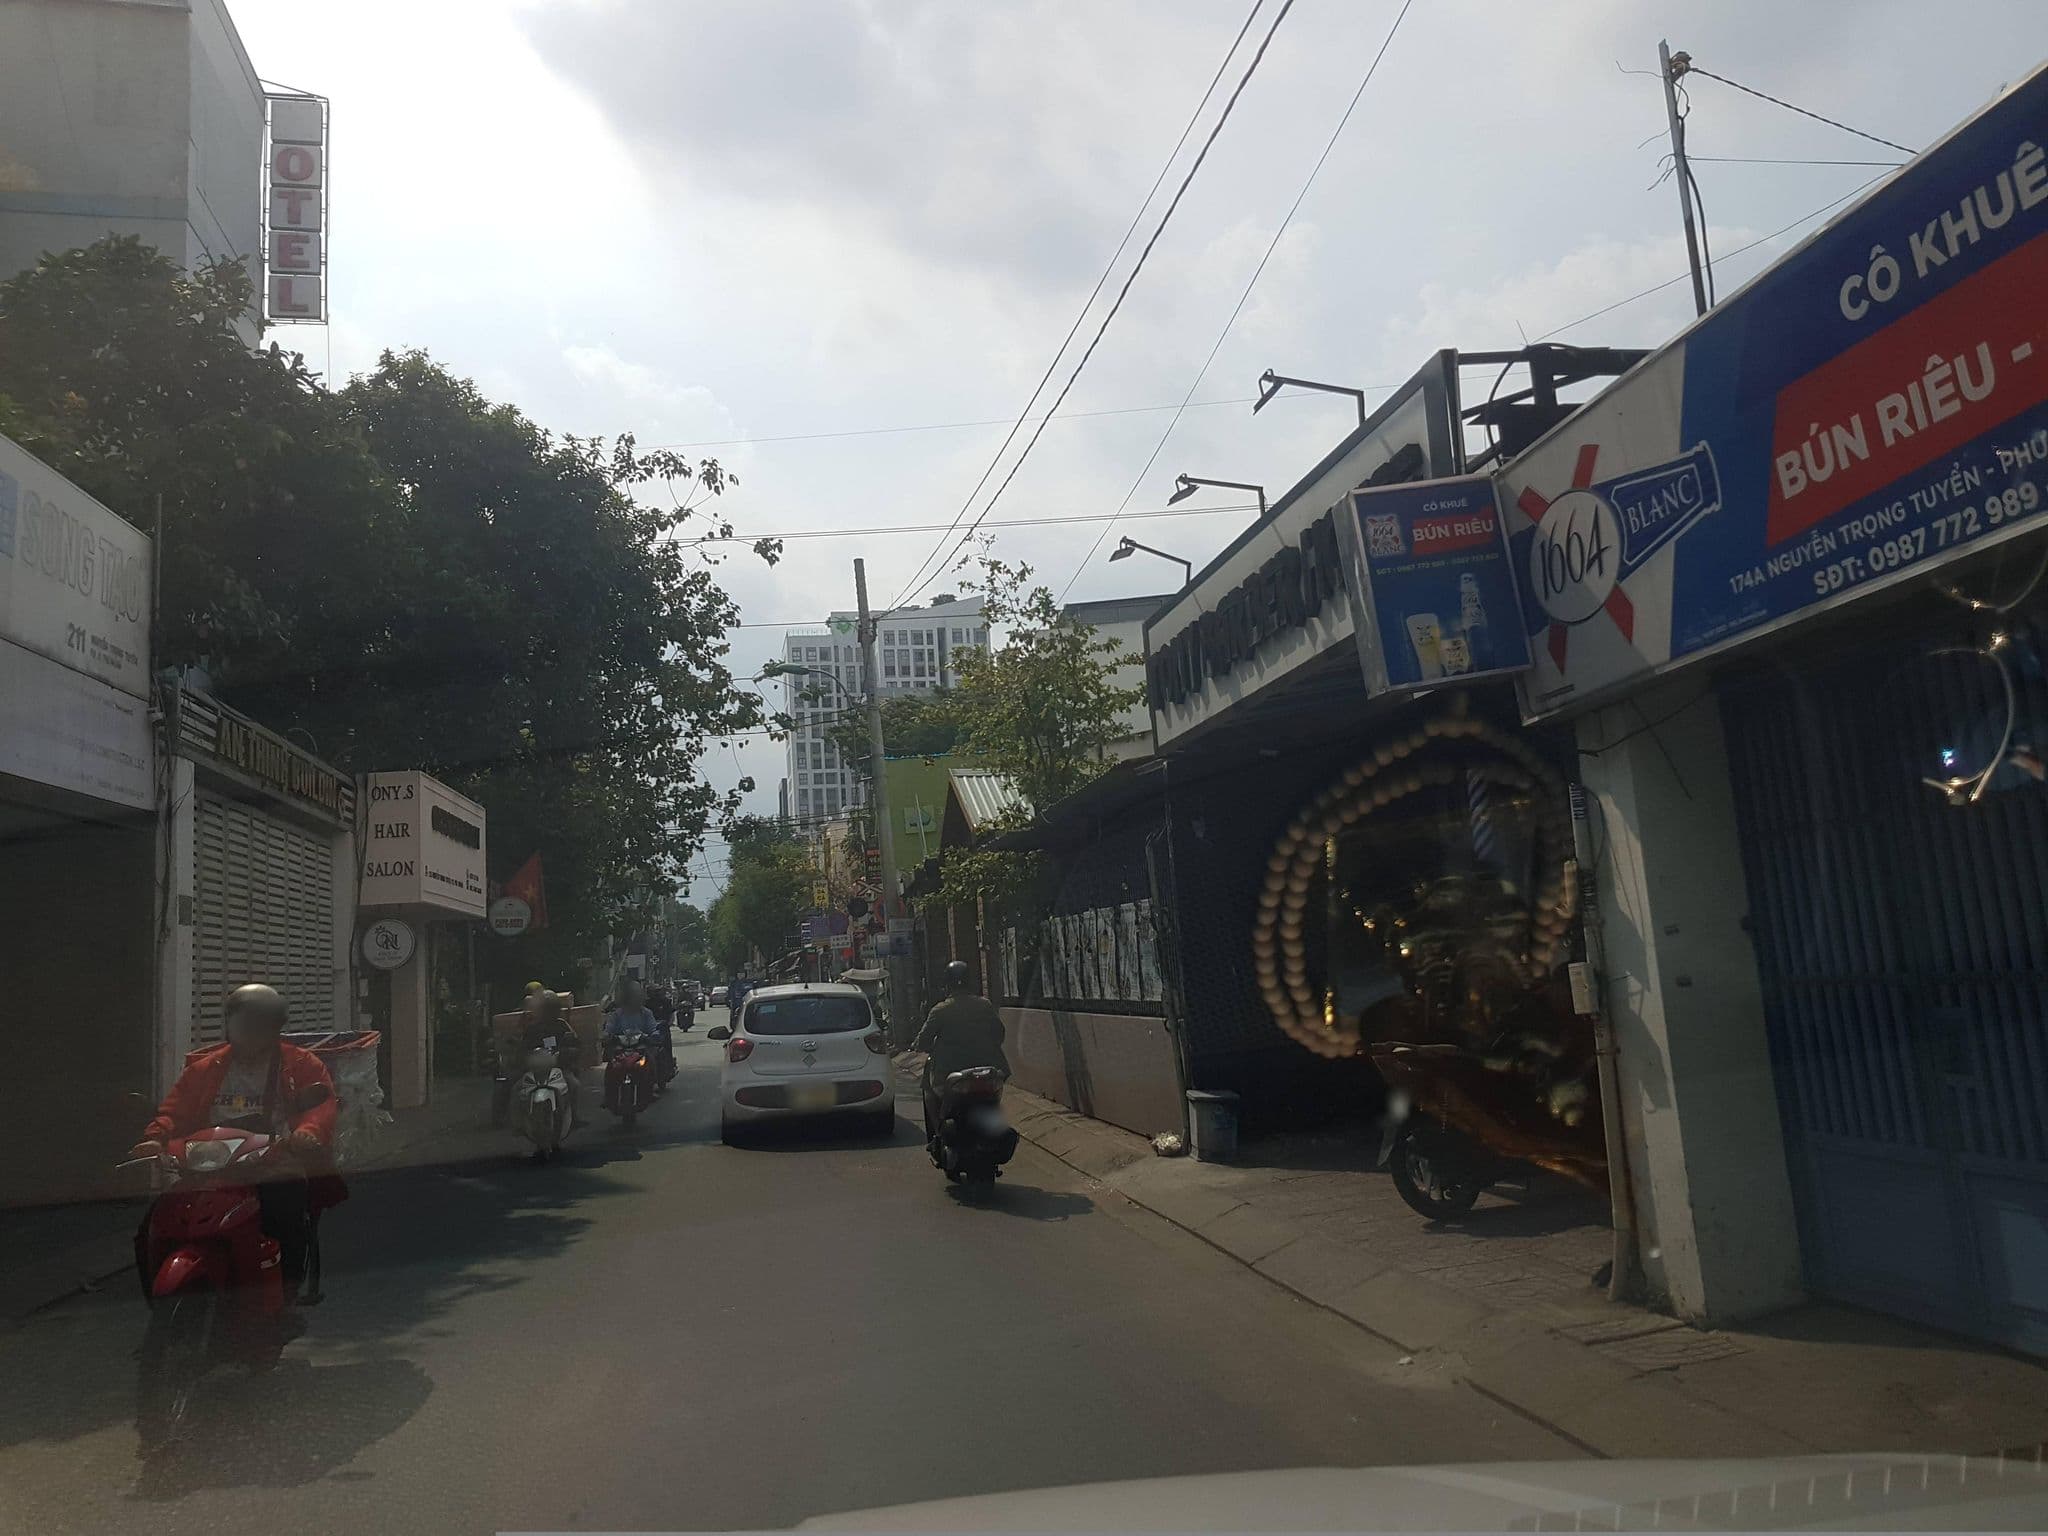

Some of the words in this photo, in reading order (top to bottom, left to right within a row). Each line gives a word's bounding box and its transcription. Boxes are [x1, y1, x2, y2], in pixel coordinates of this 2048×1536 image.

[1839, 245, 1901, 320] CÔ
[1909, 140, 2048, 280] KHUÊ
[1775, 423, 1870, 500] BÚN
[1876, 342, 1996, 448] RIÊU
[1412, 524, 1450, 542] BÚN
[1454, 517, 1494, 537] RIÊU
[1626, 473, 1695, 534] BLANC
[1729, 566, 1766, 594] 174A
[1766, 529, 1837, 578] NGUYỄN
[1838, 502, 1906, 545] TRỌNG
[1908, 461, 1981, 514] TUYỂN
[1813, 556, 1865, 594] SĐT:
[1868, 527, 1926, 571] 0987
[1932, 506, 1982, 546] 772
[1985, 481, 2039, 524] 989
[1540, 503, 1611, 601] 1664
[67, 622, 86, 654] 211
[366, 861, 415, 877] SALON
[374, 823, 411, 839] HAIR
